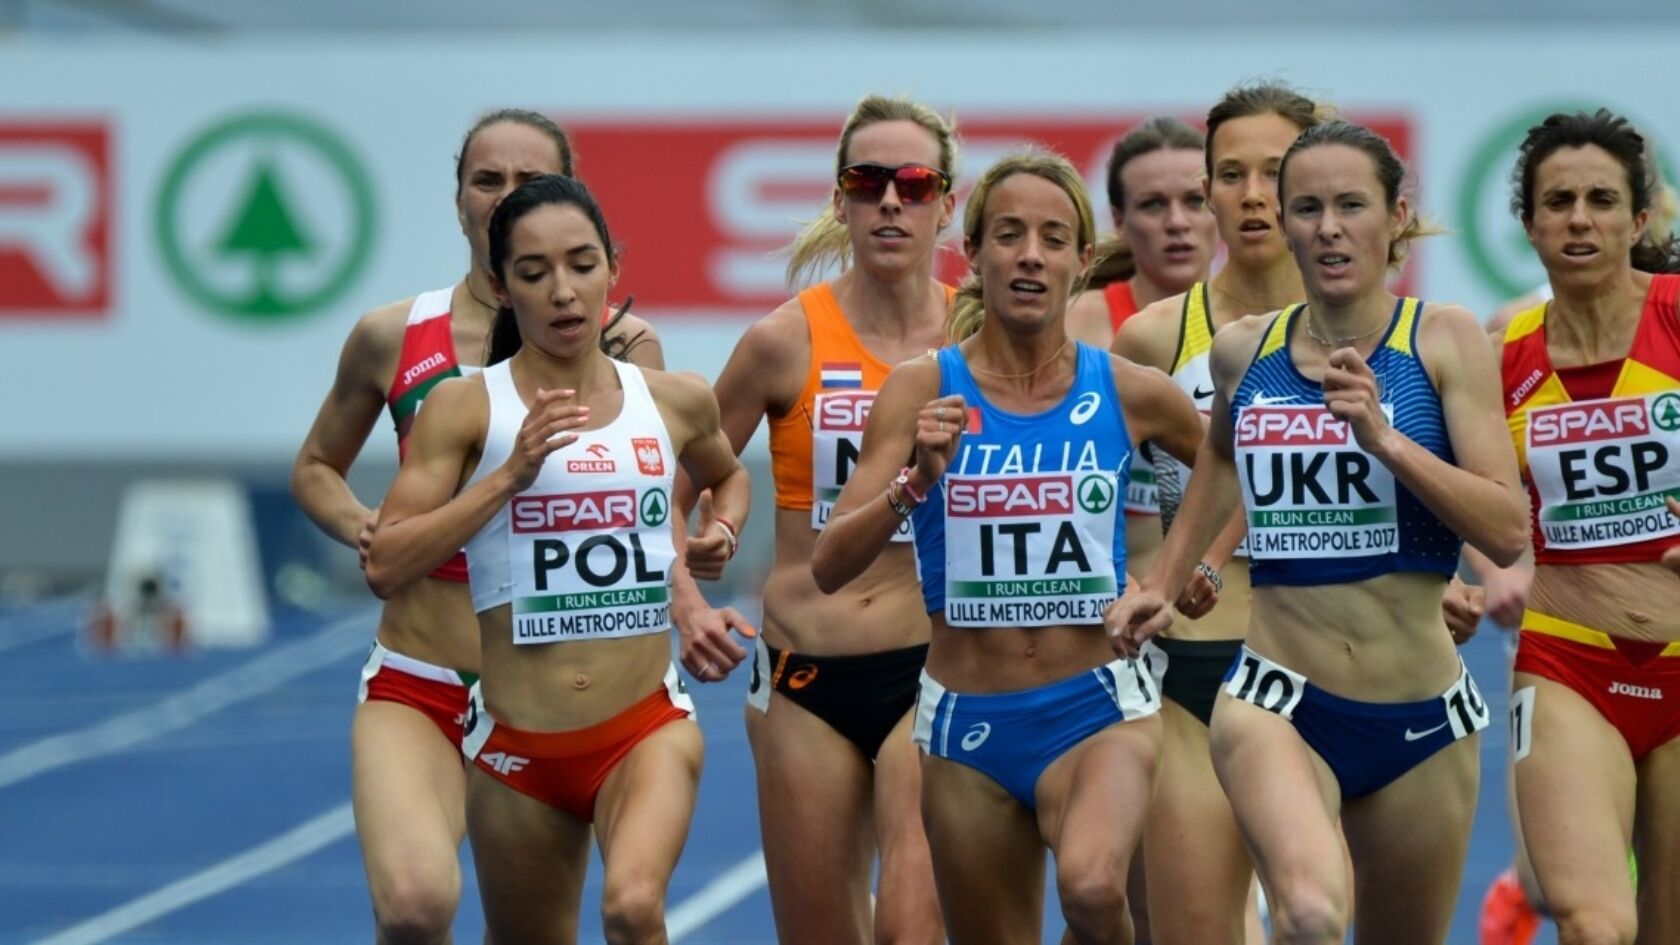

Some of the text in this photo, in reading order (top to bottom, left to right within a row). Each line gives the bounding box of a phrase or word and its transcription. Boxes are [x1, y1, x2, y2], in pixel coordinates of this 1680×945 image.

[1239, 413, 1346, 441] SPAR
[1534, 405, 1646, 441] SPAR
[569, 462, 613, 472] ORLEN
[958, 440, 1099, 475] ITALIA
[1559, 441, 1669, 501] ESP
[1245, 451, 1381, 507] UKR
[514, 495, 634, 529] SPAR
[951, 482, 1070, 512] SPAR
[1575, 493, 1665, 517] I RUN CLEAN
[1263, 511, 1354, 525] I RUN CLEAN
[1581, 512, 1675, 542] METROPOLE
[979, 521, 1092, 577] ITA
[1265, 530, 1361, 552] METROPOLE
[1364, 528, 1396, 549] 2017
[534, 533, 664, 591] POL
[556, 590, 646, 609] I RUN CLEAN
[987, 580, 1082, 596] I RUN CLEAN
[518, 617, 557, 638] LILLE
[559, 609, 650, 636] METROPOLE
[949, 602, 987, 622] LILLE
[989, 600, 1087, 622] METROPOLE
[1236, 656, 1294, 715] 10
